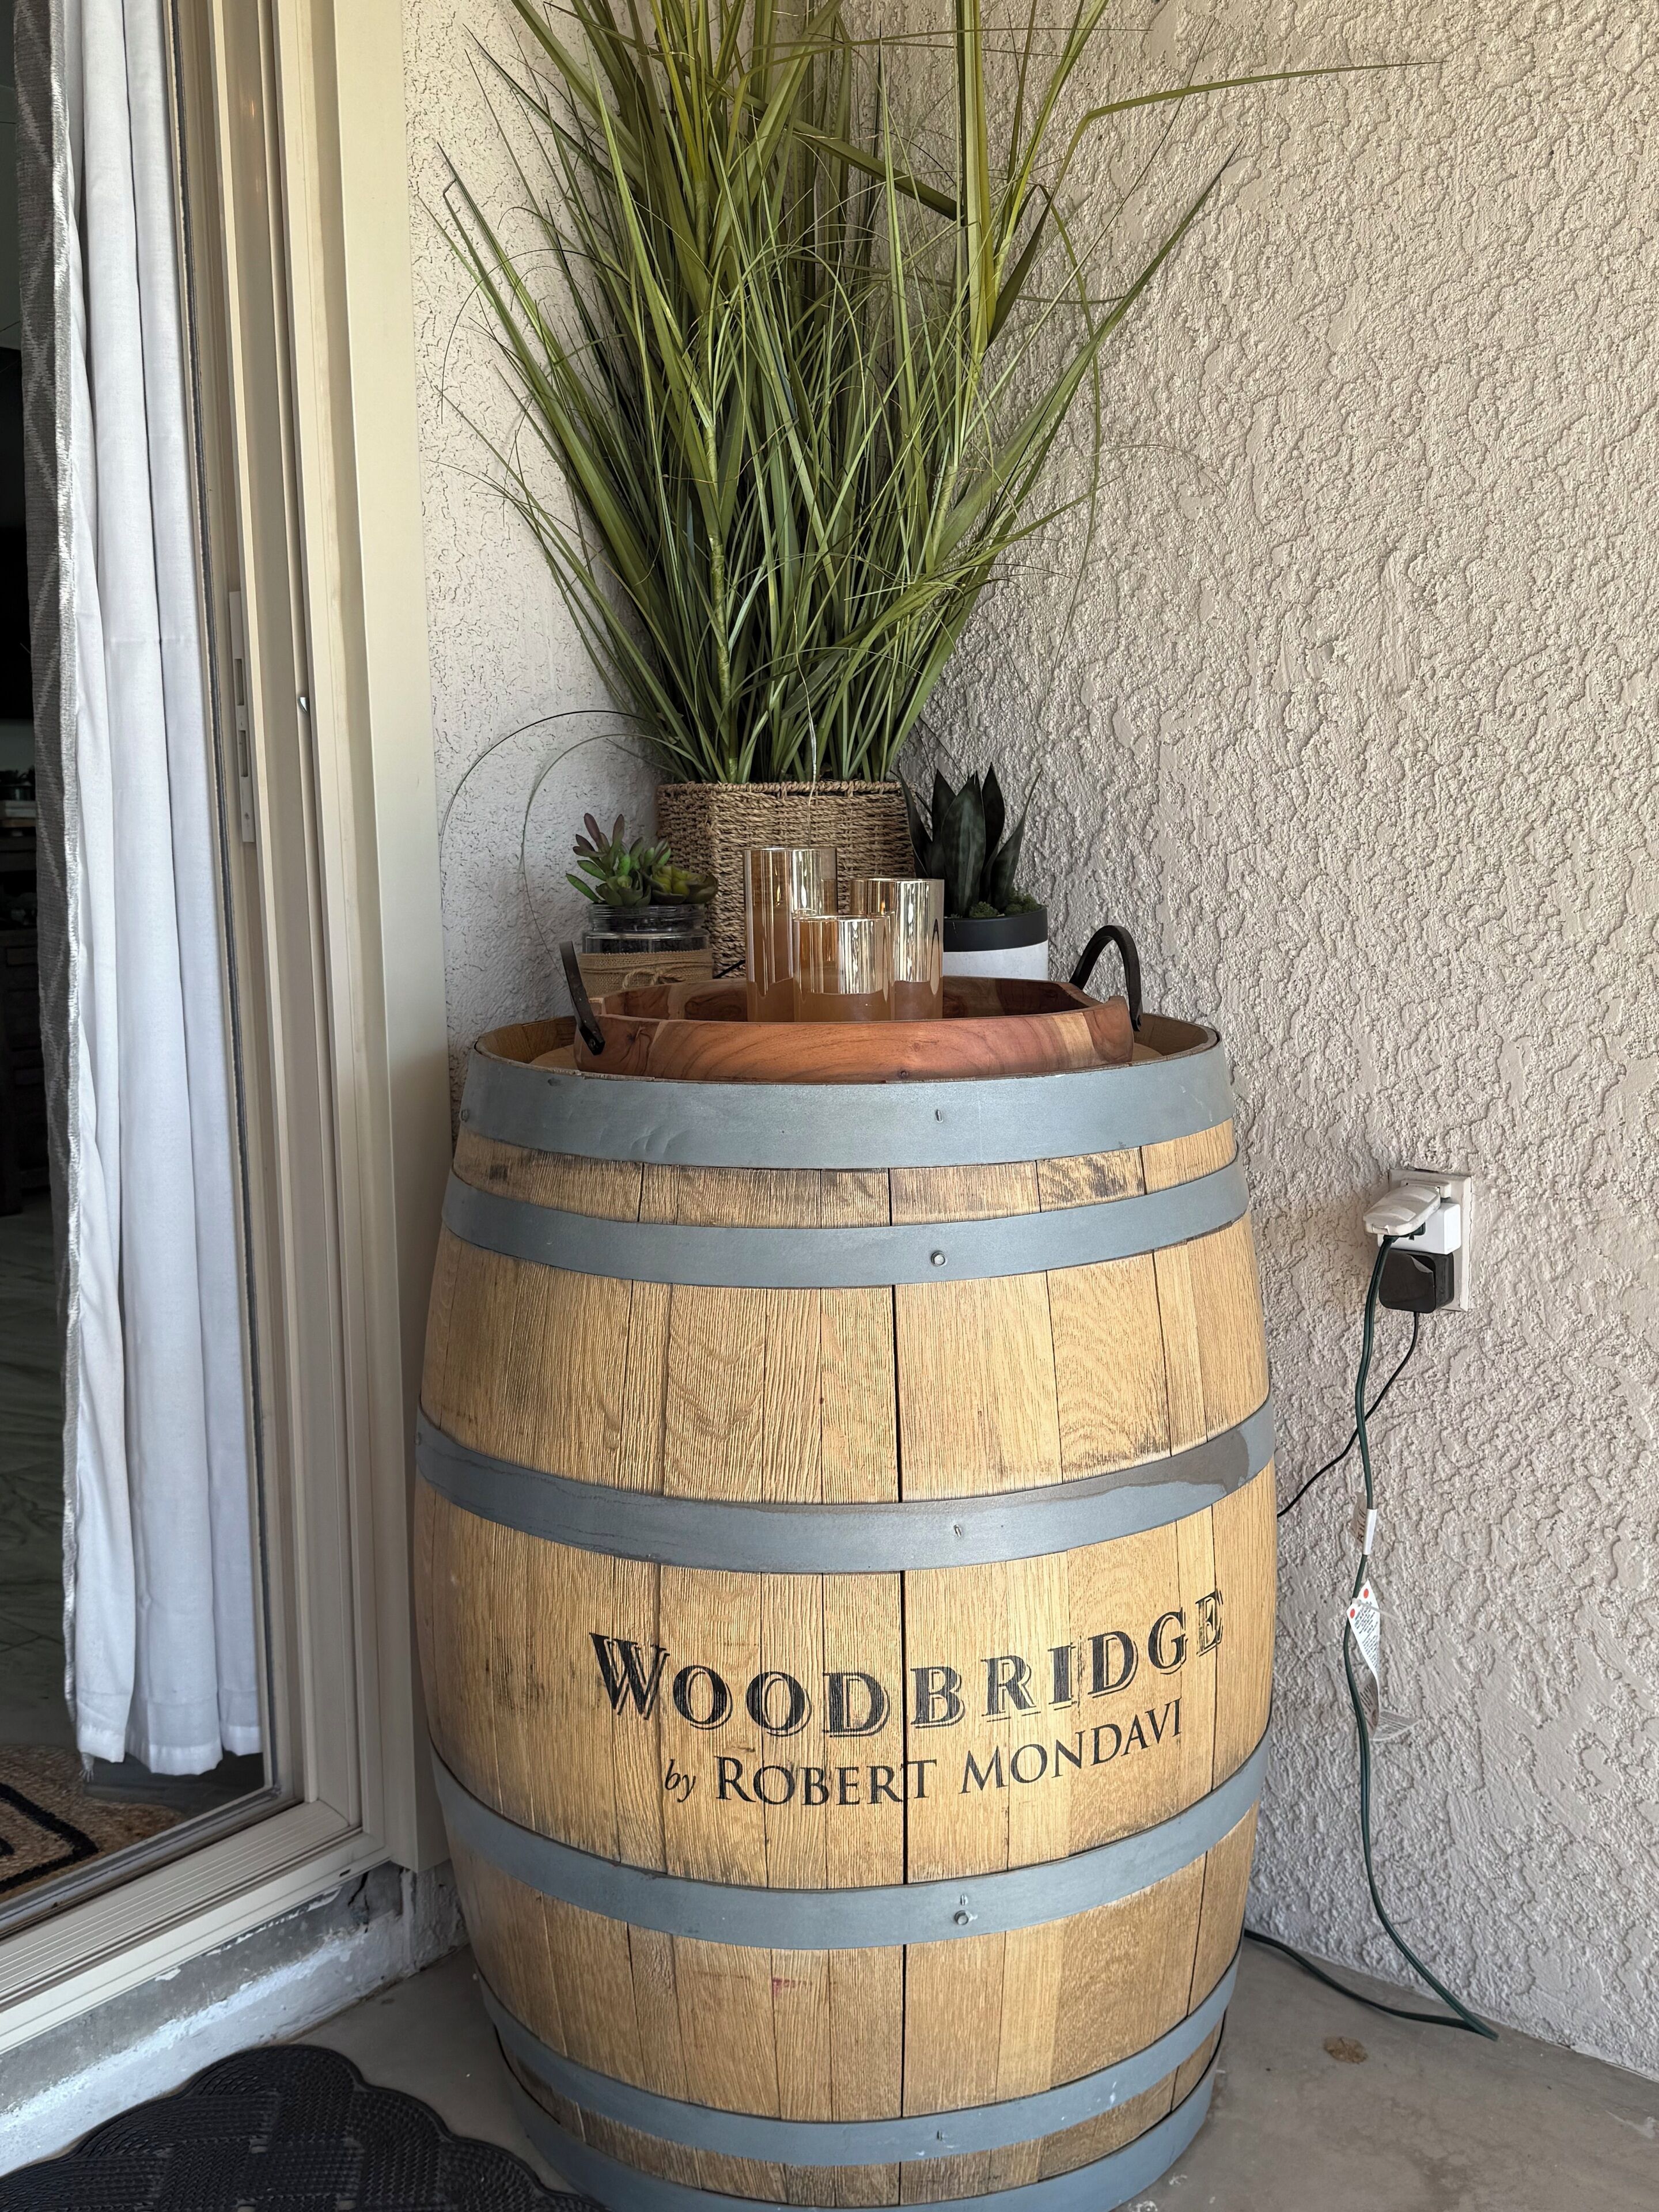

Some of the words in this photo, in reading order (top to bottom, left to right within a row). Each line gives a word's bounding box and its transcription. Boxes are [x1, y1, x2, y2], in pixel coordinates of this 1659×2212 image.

[589, 1588, 1223, 1737] WOODBRIDGE
[664, 1759, 696, 1803] by
[714, 1755, 938, 1806] ROBERT
[958, 1696, 1182, 1794] MONDAVI
